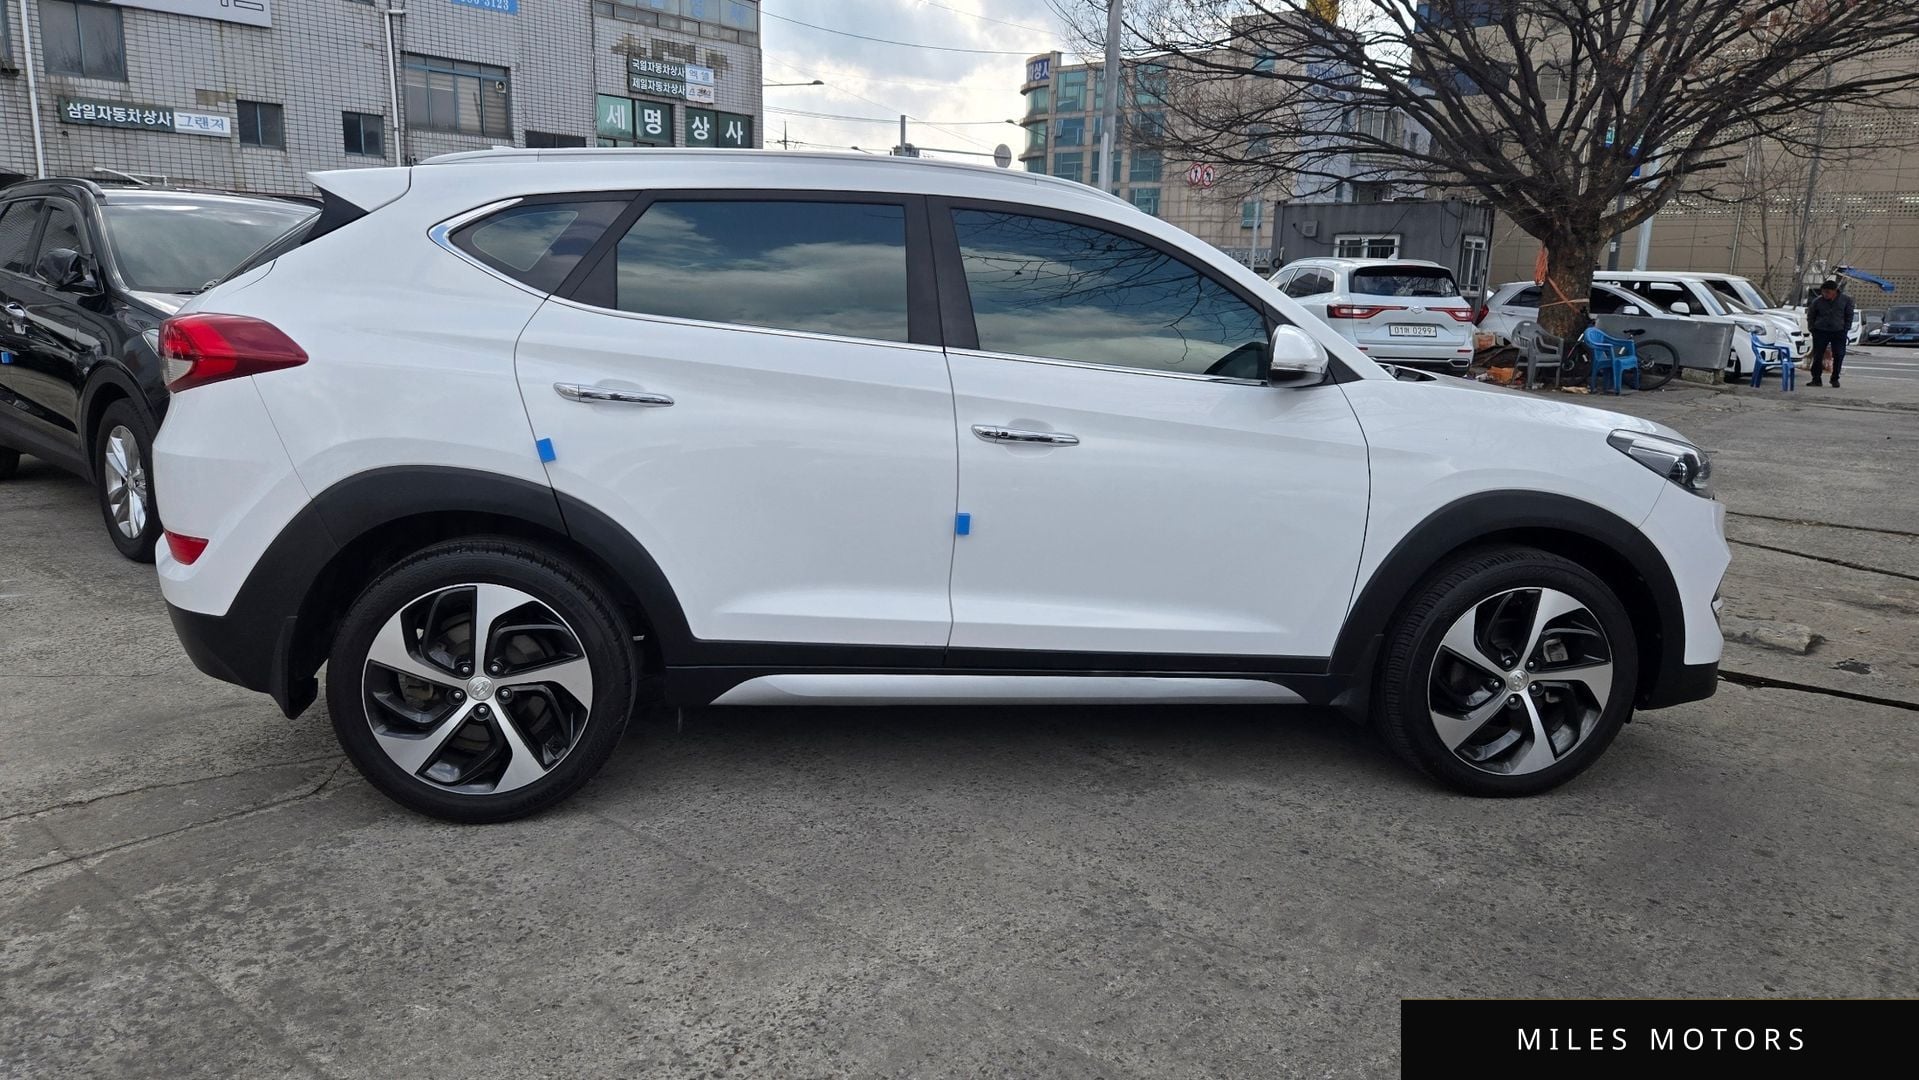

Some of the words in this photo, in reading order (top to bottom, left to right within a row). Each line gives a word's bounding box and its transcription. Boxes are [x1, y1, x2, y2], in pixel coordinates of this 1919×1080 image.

[632, 77, 685, 96] 제일자동차상사
[67, 102, 172, 127] 삼일자동차상사
[1412, 326, 1433, 335] 0299
